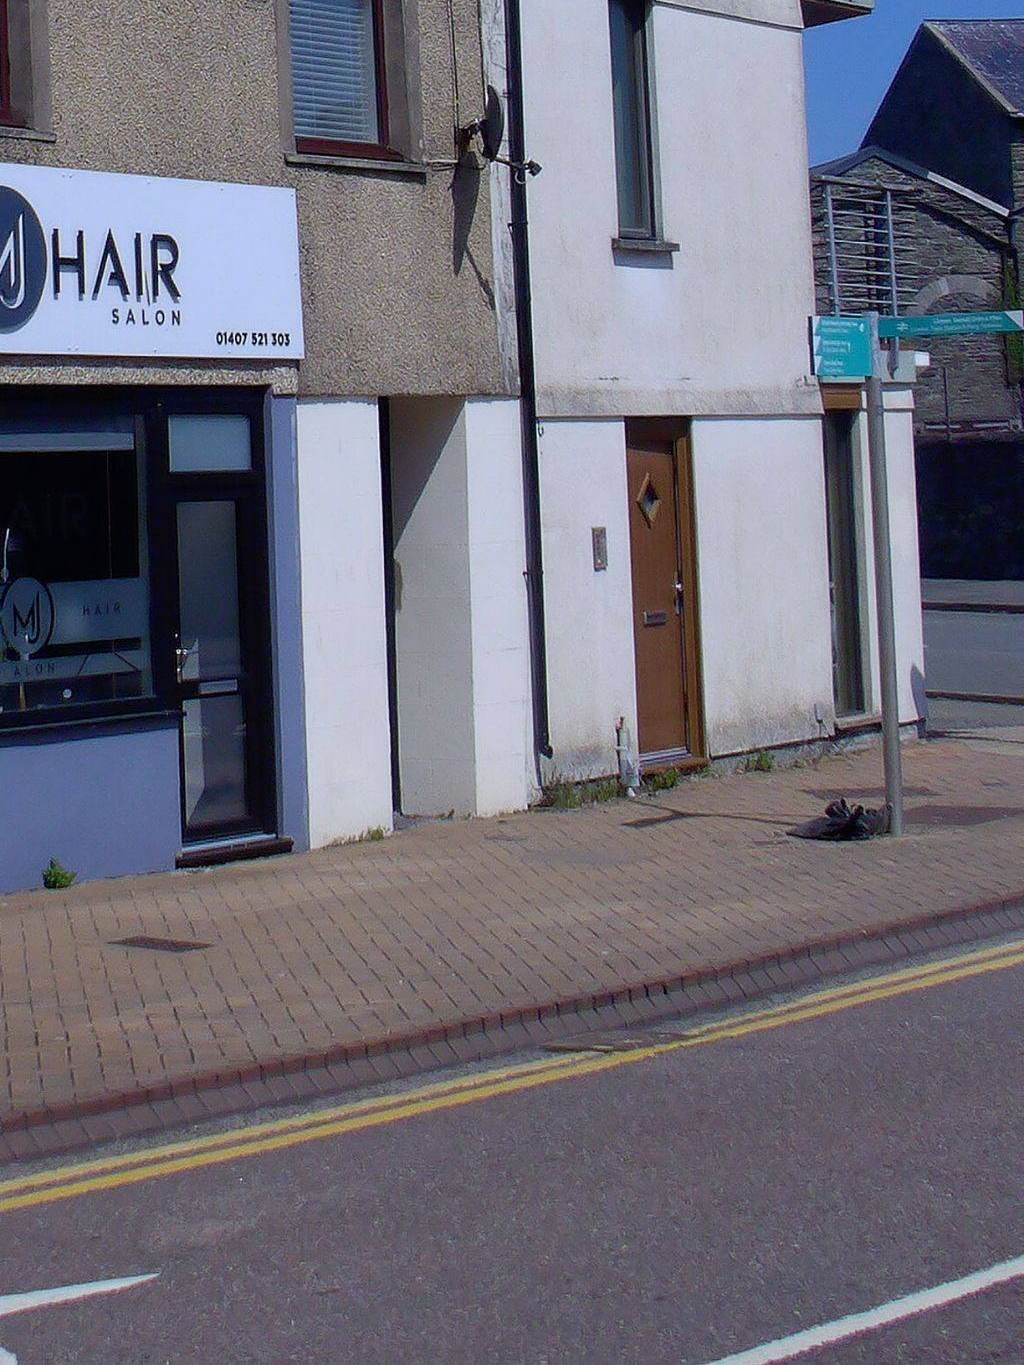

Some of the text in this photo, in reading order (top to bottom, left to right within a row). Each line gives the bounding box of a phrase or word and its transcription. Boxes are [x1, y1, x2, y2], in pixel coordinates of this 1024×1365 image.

[52, 227, 182, 305] HAIR
[111, 308, 182, 327] SALON
[215, 331, 291, 347] 01407 521 303
